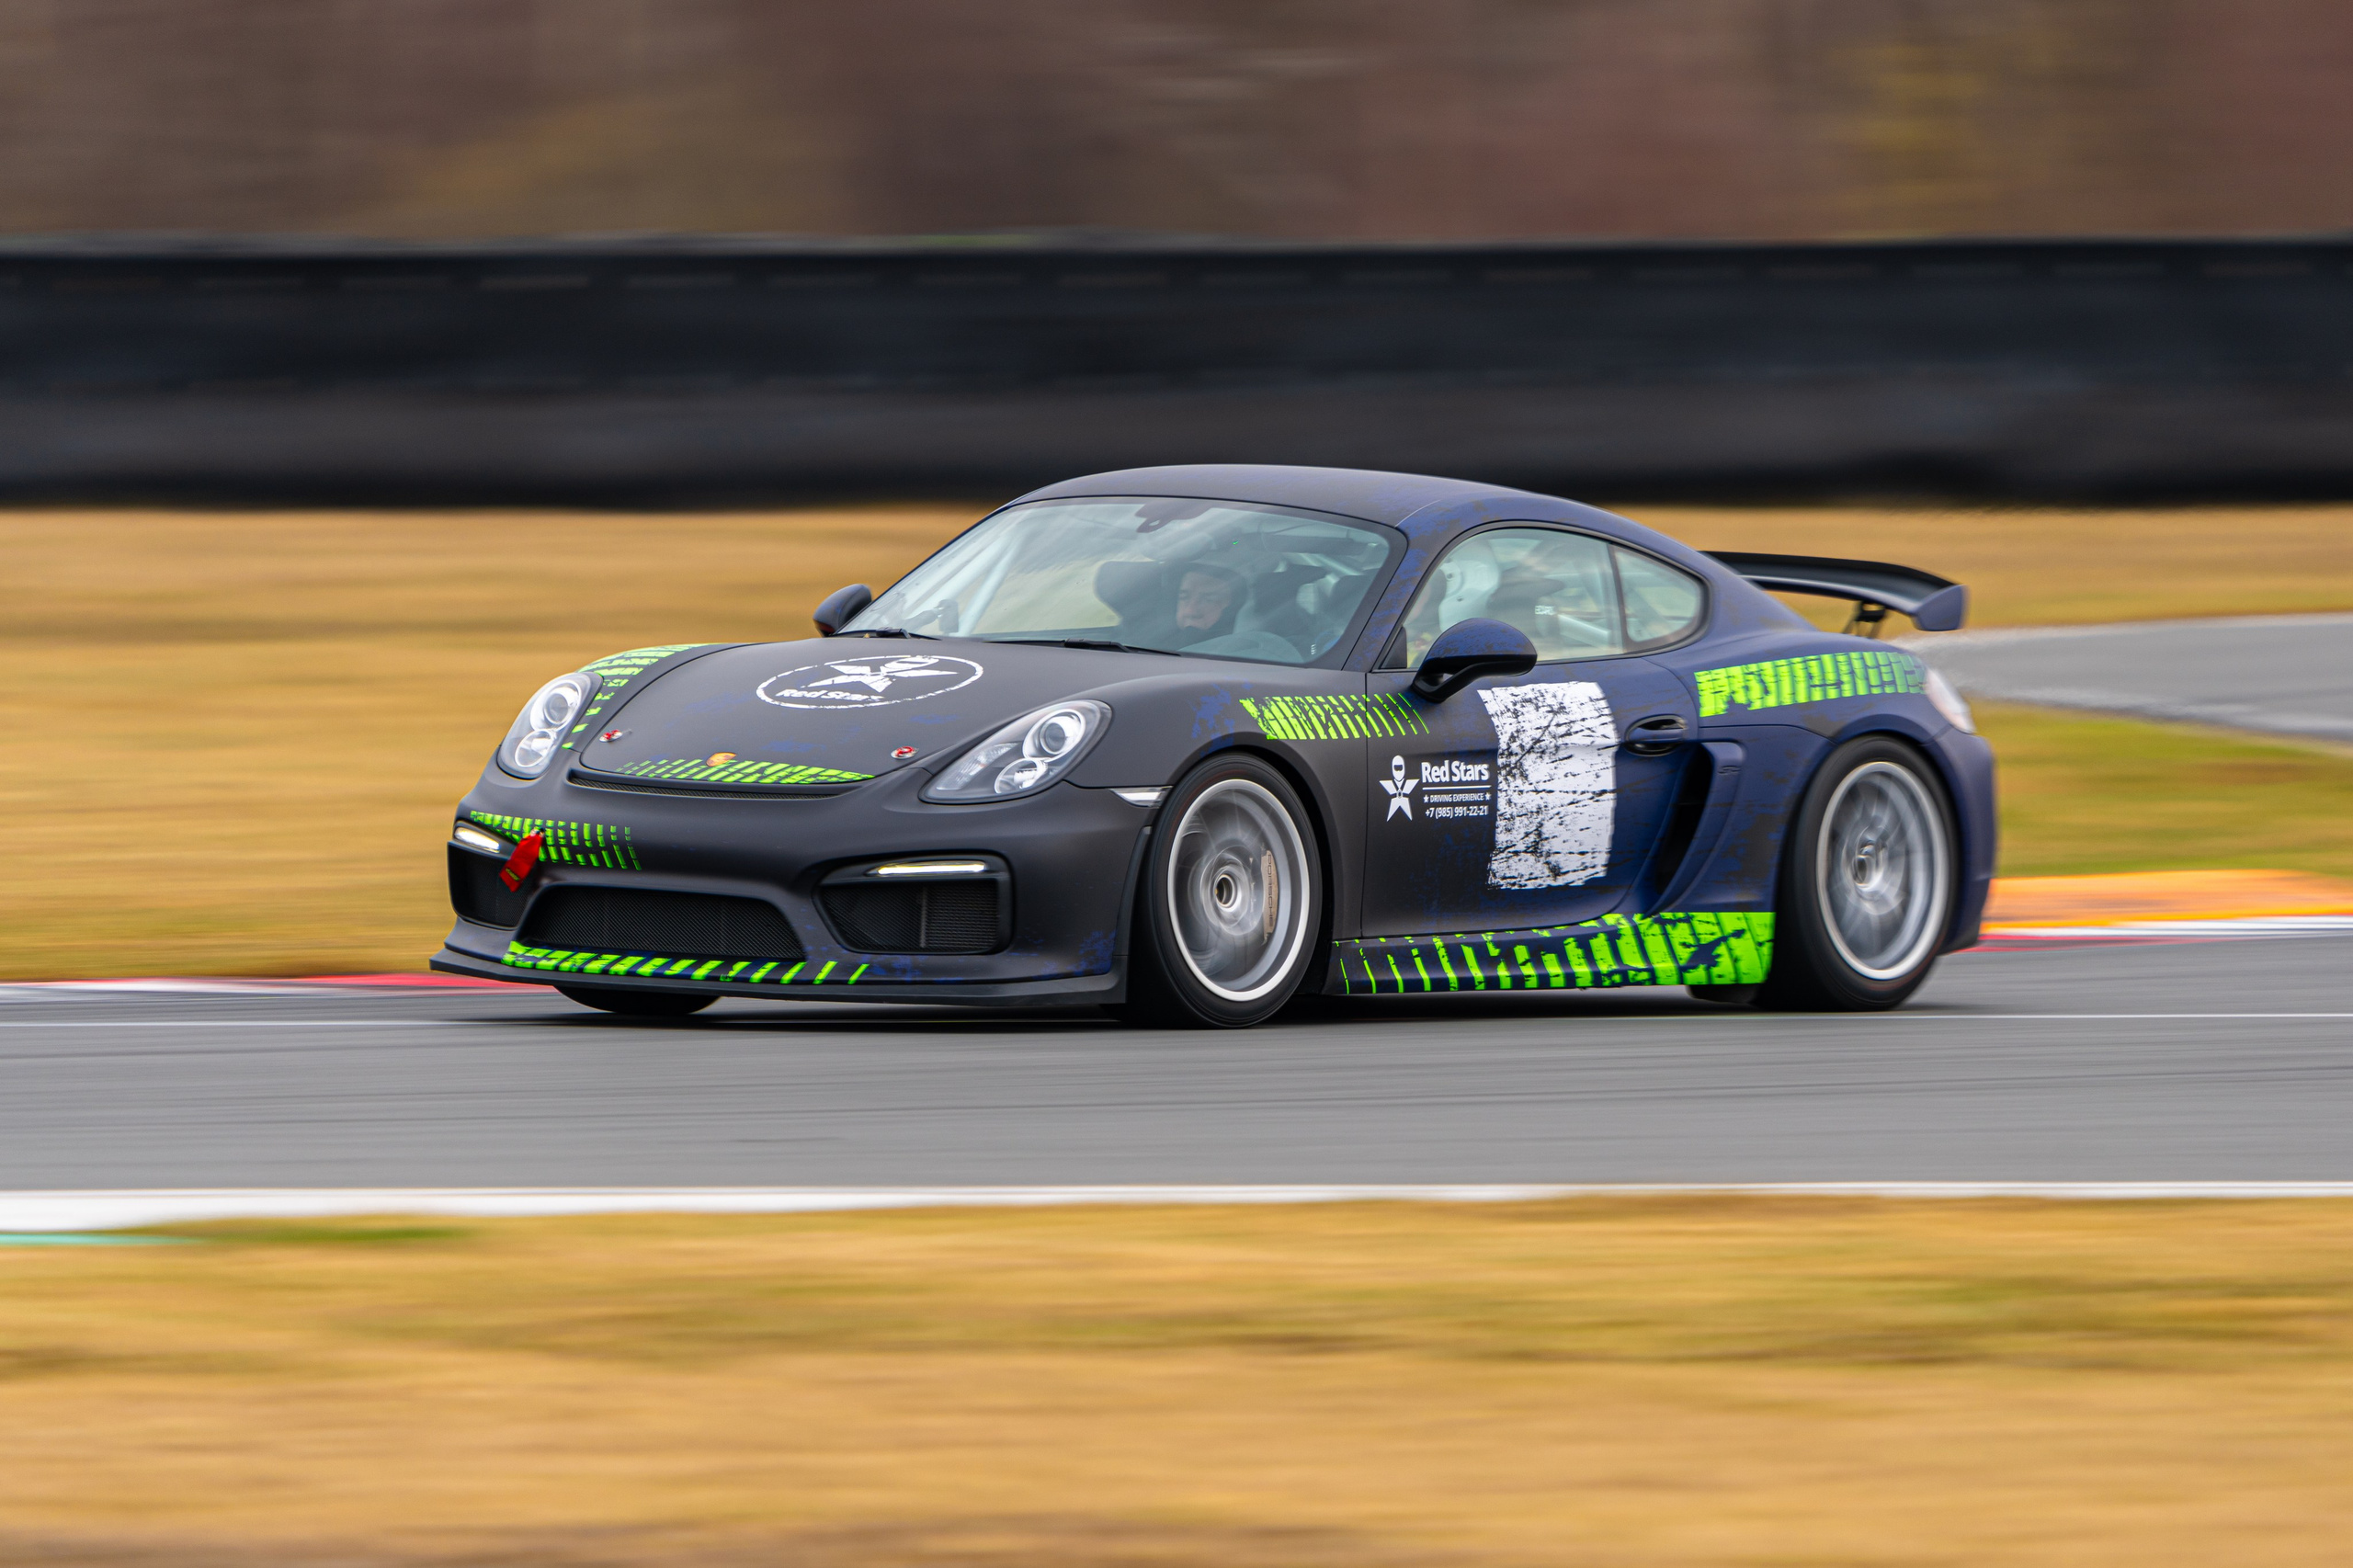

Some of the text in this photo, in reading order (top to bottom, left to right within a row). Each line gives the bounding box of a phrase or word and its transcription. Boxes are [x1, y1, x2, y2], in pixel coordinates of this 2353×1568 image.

[775, 688, 827, 699] Red
[1421, 759, 1490, 783] Red Stars
[1429, 792, 1484, 803] DRIVING EXPERIENCE
[1425, 805, 1489, 819] +7 (985) 991-22-21
